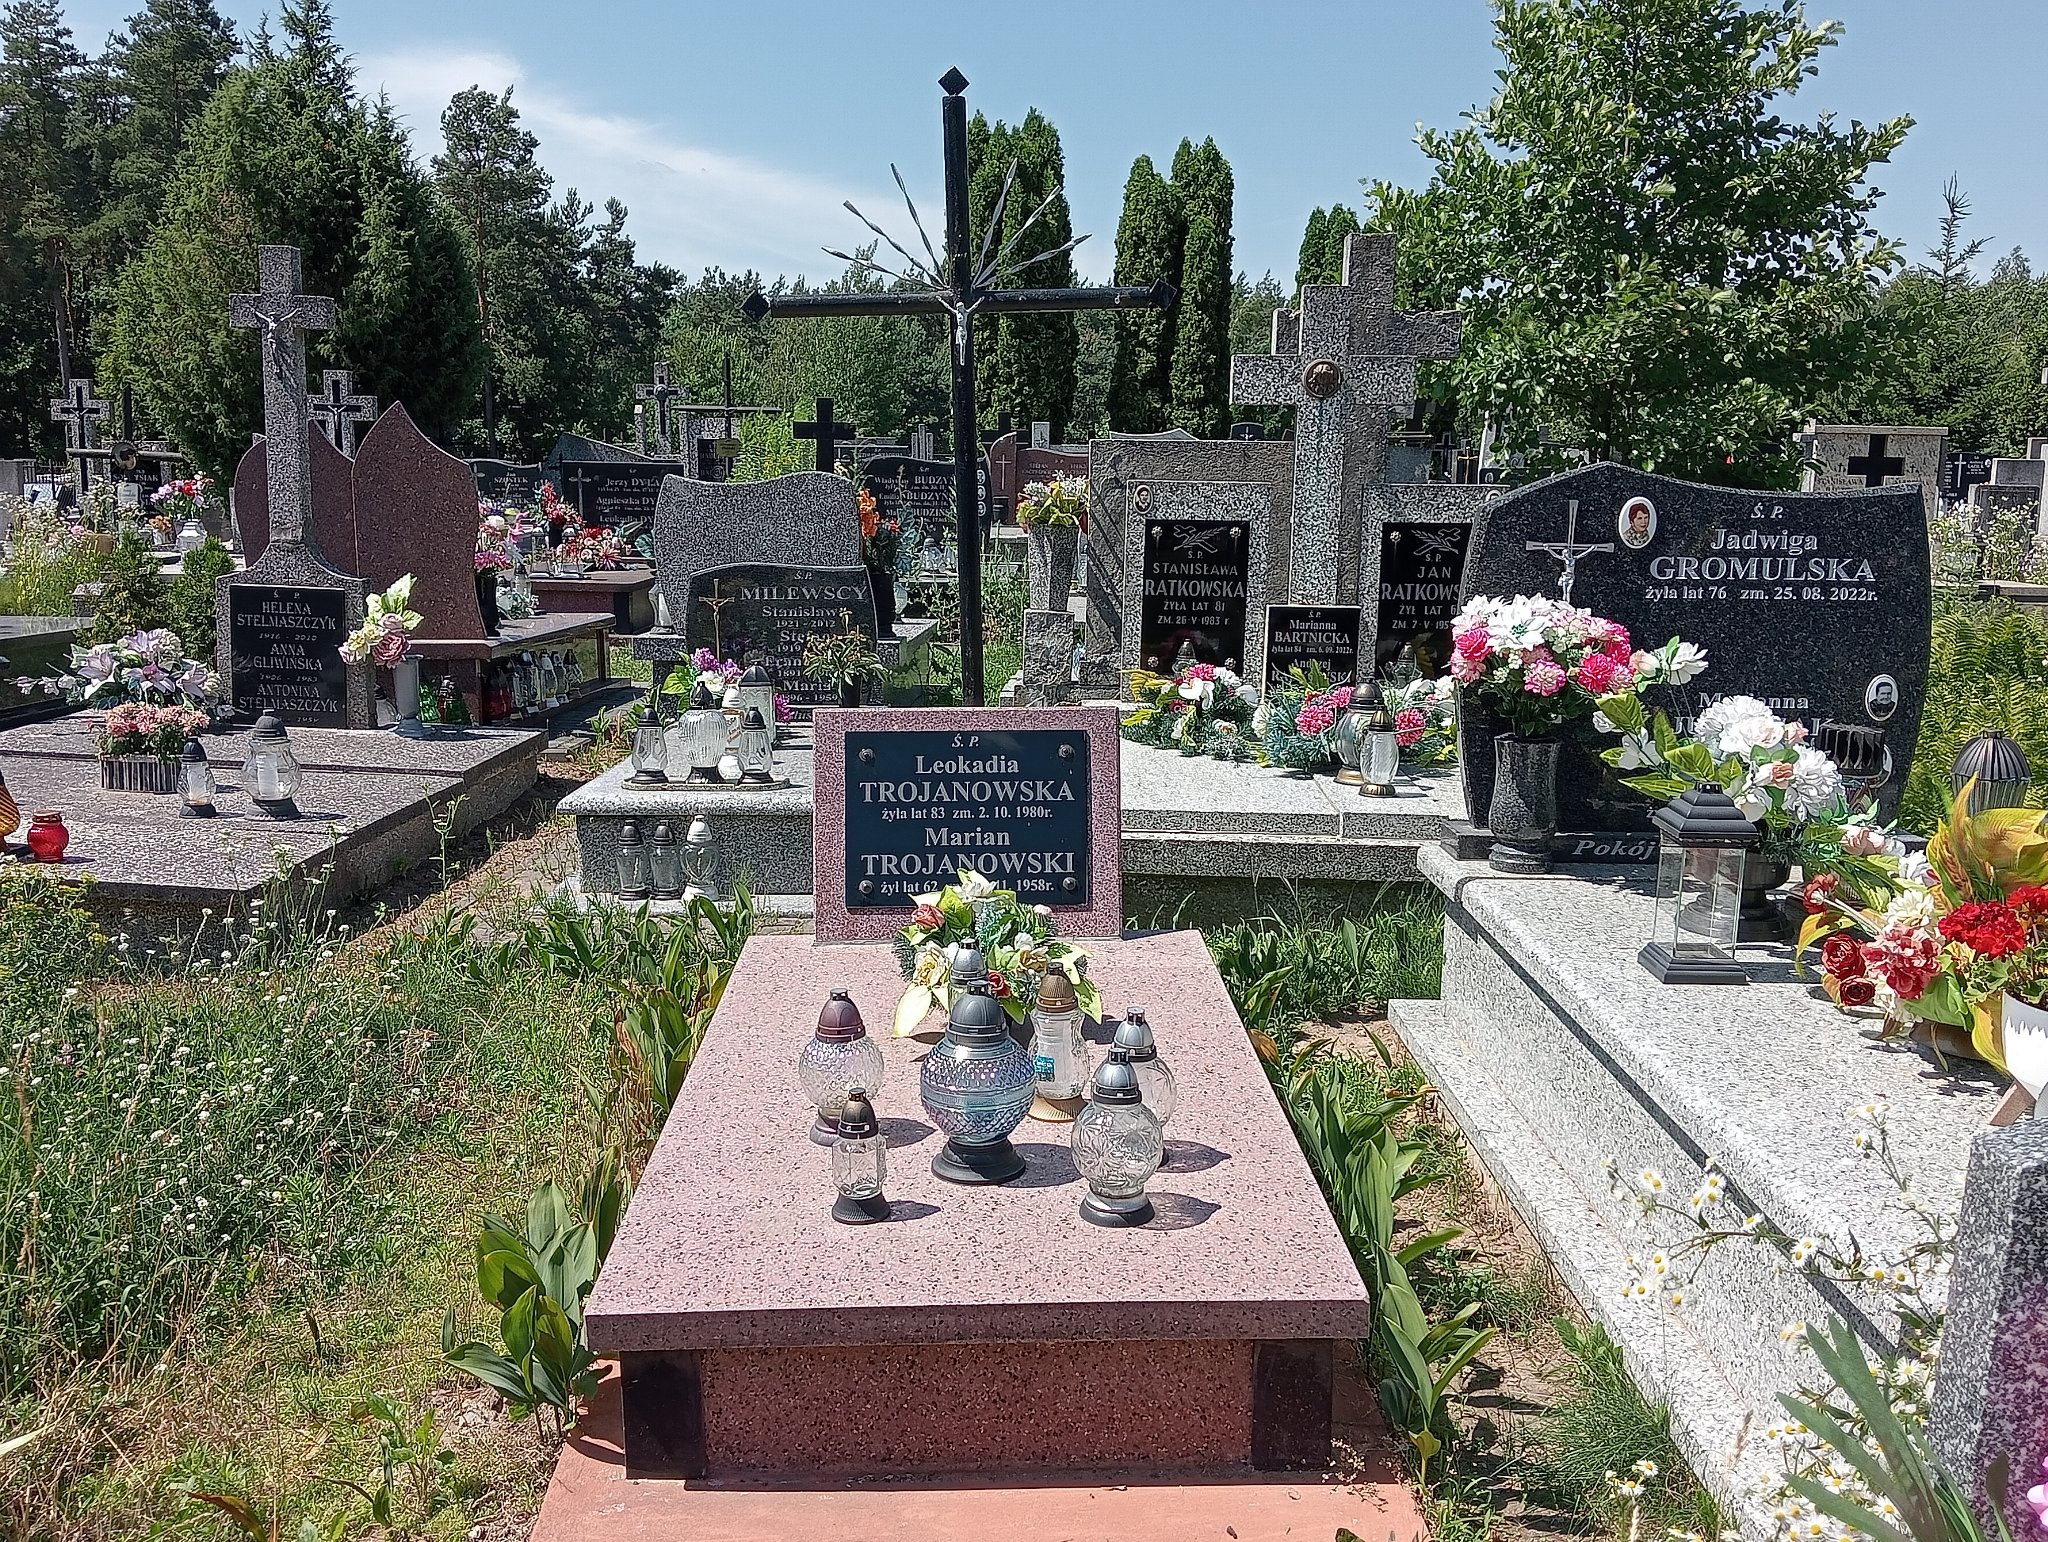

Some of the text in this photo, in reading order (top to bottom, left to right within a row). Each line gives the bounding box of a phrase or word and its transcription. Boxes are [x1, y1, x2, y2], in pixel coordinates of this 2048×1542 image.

[1710, 528, 1818, 556] Jadwiga
[1152, 562, 1238, 576] STANISŁAWA
[1417, 566, 1452, 579] JAN
[1649, 556, 1876, 582] GROMULSKA
[740, 585, 868, 601] MILEWSCY
[1144, 578, 1245, 598] RATKOWSKA
[1683, 585, 1704, 599] lat
[1708, 586, 1727, 599] 76
[1740, 589, 1769, 600] zm.
[1774, 586, 1797, 600] 25.
[1802, 586, 1825, 600] 08.
[1830, 586, 1878, 601] 2022r.
[262, 601, 312, 615] HELENA
[1163, 599, 1225, 612] ŻYŁA LAT 81
[1424, 605, 1443, 615] LAT
[236, 614, 337, 630] STELMASZCZYK
[1289, 619, 1337, 630] Marianna
[1274, 631, 1350, 644] BARTNICKA
[270, 643, 306, 656] ANNA
[256, 683, 320, 698] ANTONINA
[782, 680, 832, 691] Maria
[239, 696, 338, 713] STELMASZCZYK
[951, 733, 980, 748] Ś. P.
[915, 755, 1019, 774] Leokadia
[859, 780, 1075, 803] TROJANOWSKA
[911, 807, 927, 819] lat
[930, 806, 946, 819] 83
[952, 809, 975, 819] zm.
[978, 806, 990, 819] 2.
[993, 806, 1012, 818] 10.
[1015, 805, 1053, 818] 1980r.
[924, 827, 1010, 847] Marian
[1571, 839, 1656, 860] Pokój
[861, 852, 1075, 876] TROJANOWSKI
[903, 880, 920, 893] lat
[924, 880, 938, 893] 62
[1016, 879, 1054, 892] 1958r.
